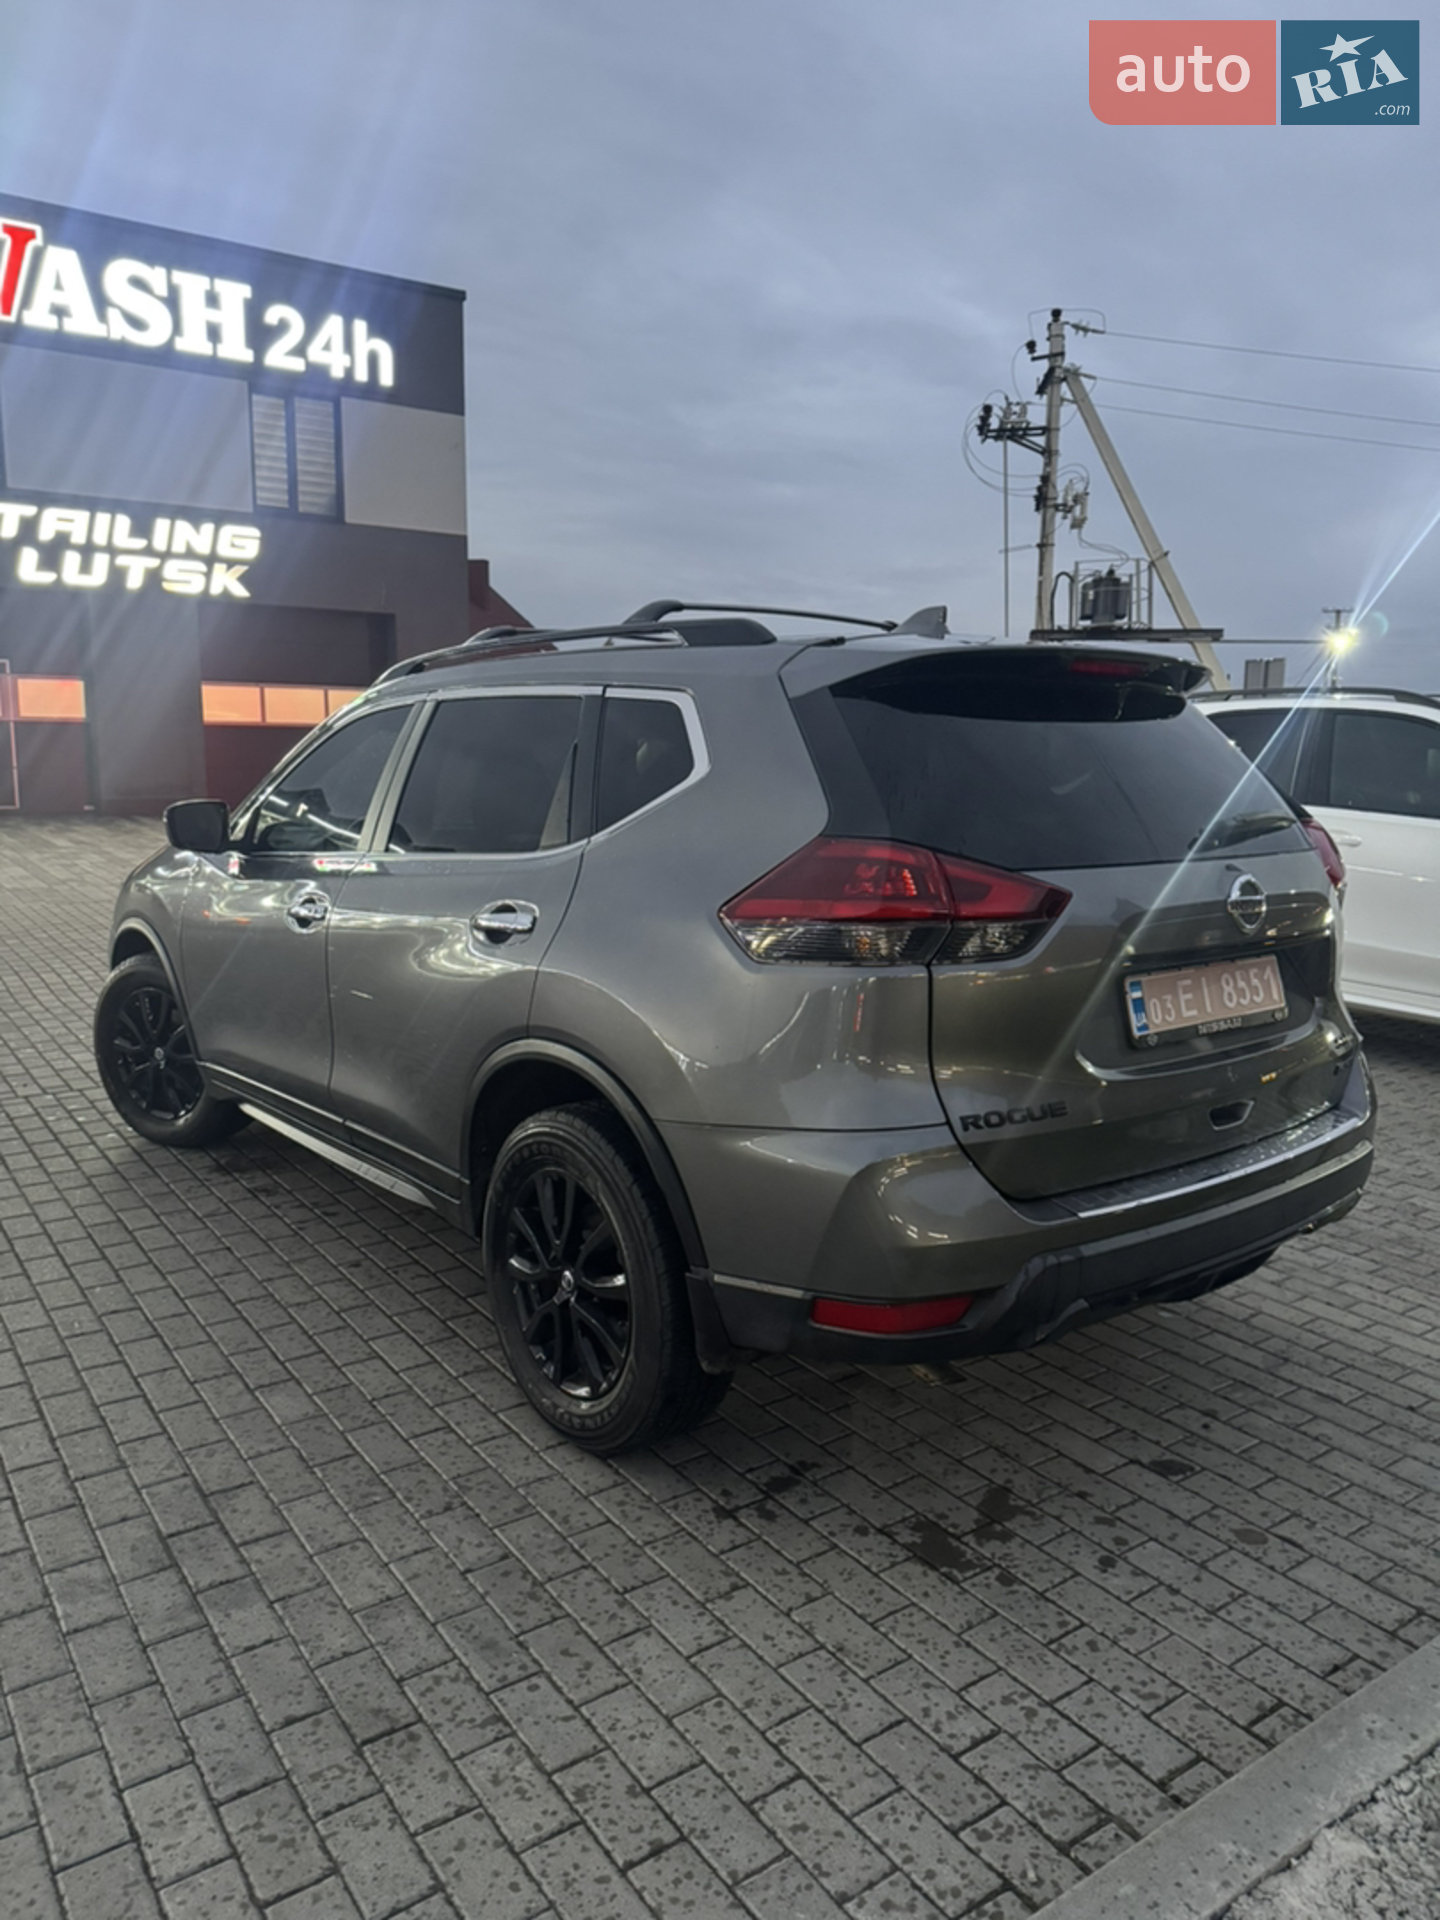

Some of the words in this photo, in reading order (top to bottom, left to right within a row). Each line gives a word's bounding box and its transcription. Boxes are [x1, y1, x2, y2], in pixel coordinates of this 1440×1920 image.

[263, 303, 394, 388] 24h
[17, 546, 251, 598] LUTSK
[1220, 965, 1280, 1008] 8551
[959, 1100, 1069, 1132] ROGUE
